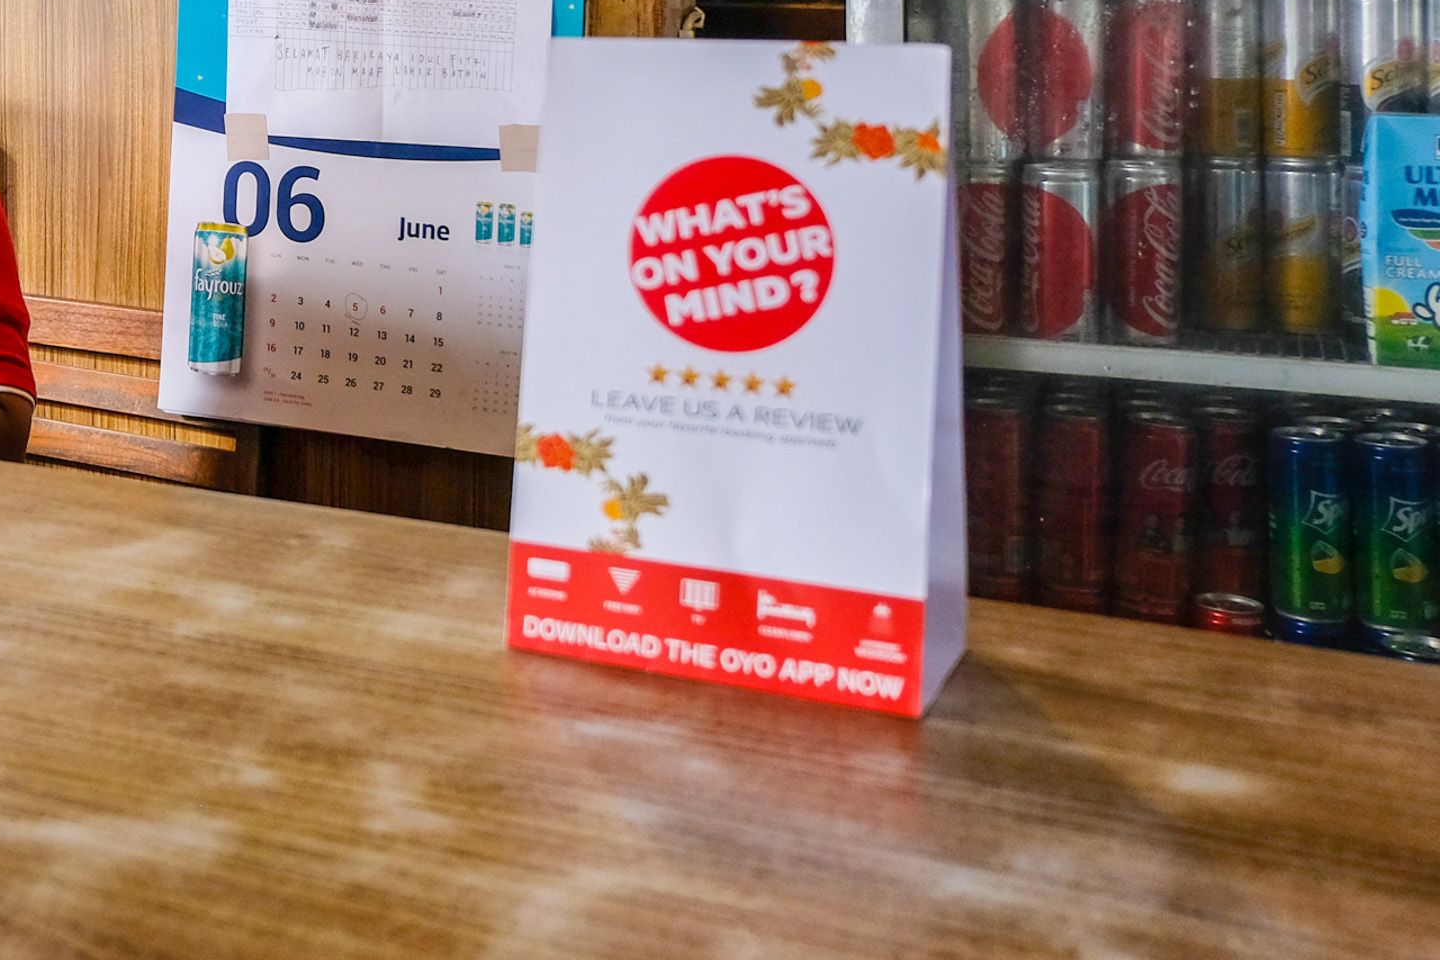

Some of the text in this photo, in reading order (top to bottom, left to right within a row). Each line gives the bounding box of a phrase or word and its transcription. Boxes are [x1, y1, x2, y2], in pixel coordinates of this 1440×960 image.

[223, 160, 325, 243] 06
[635, 184, 812, 247] WHAT'S
[398, 216, 450, 241] June
[630, 224, 834, 291] ON YOUR
[1384, 255, 1423, 268] FULL
[194, 269, 244, 301] fayrouz
[439, 286, 443, 295] 1
[664, 268, 820, 327] MIND?
[271, 294, 442, 321] 2 3 4 5 6 7 8
[269, 318, 444, 347] 9 10 11 12 13 14 15
[267, 343, 443, 372] 16 17 18 19 20 21 22
[290, 371, 441, 398] 24 25 26 27 28 29
[591, 389, 864, 437] LEAVE US A REVIEW
[522, 614, 661, 658] DOWNLOAD
[664, 638, 718, 669] THE
[720, 647, 777, 679] OYO
[778, 658, 836, 687] APP
[837, 665, 905, 701] NOW
